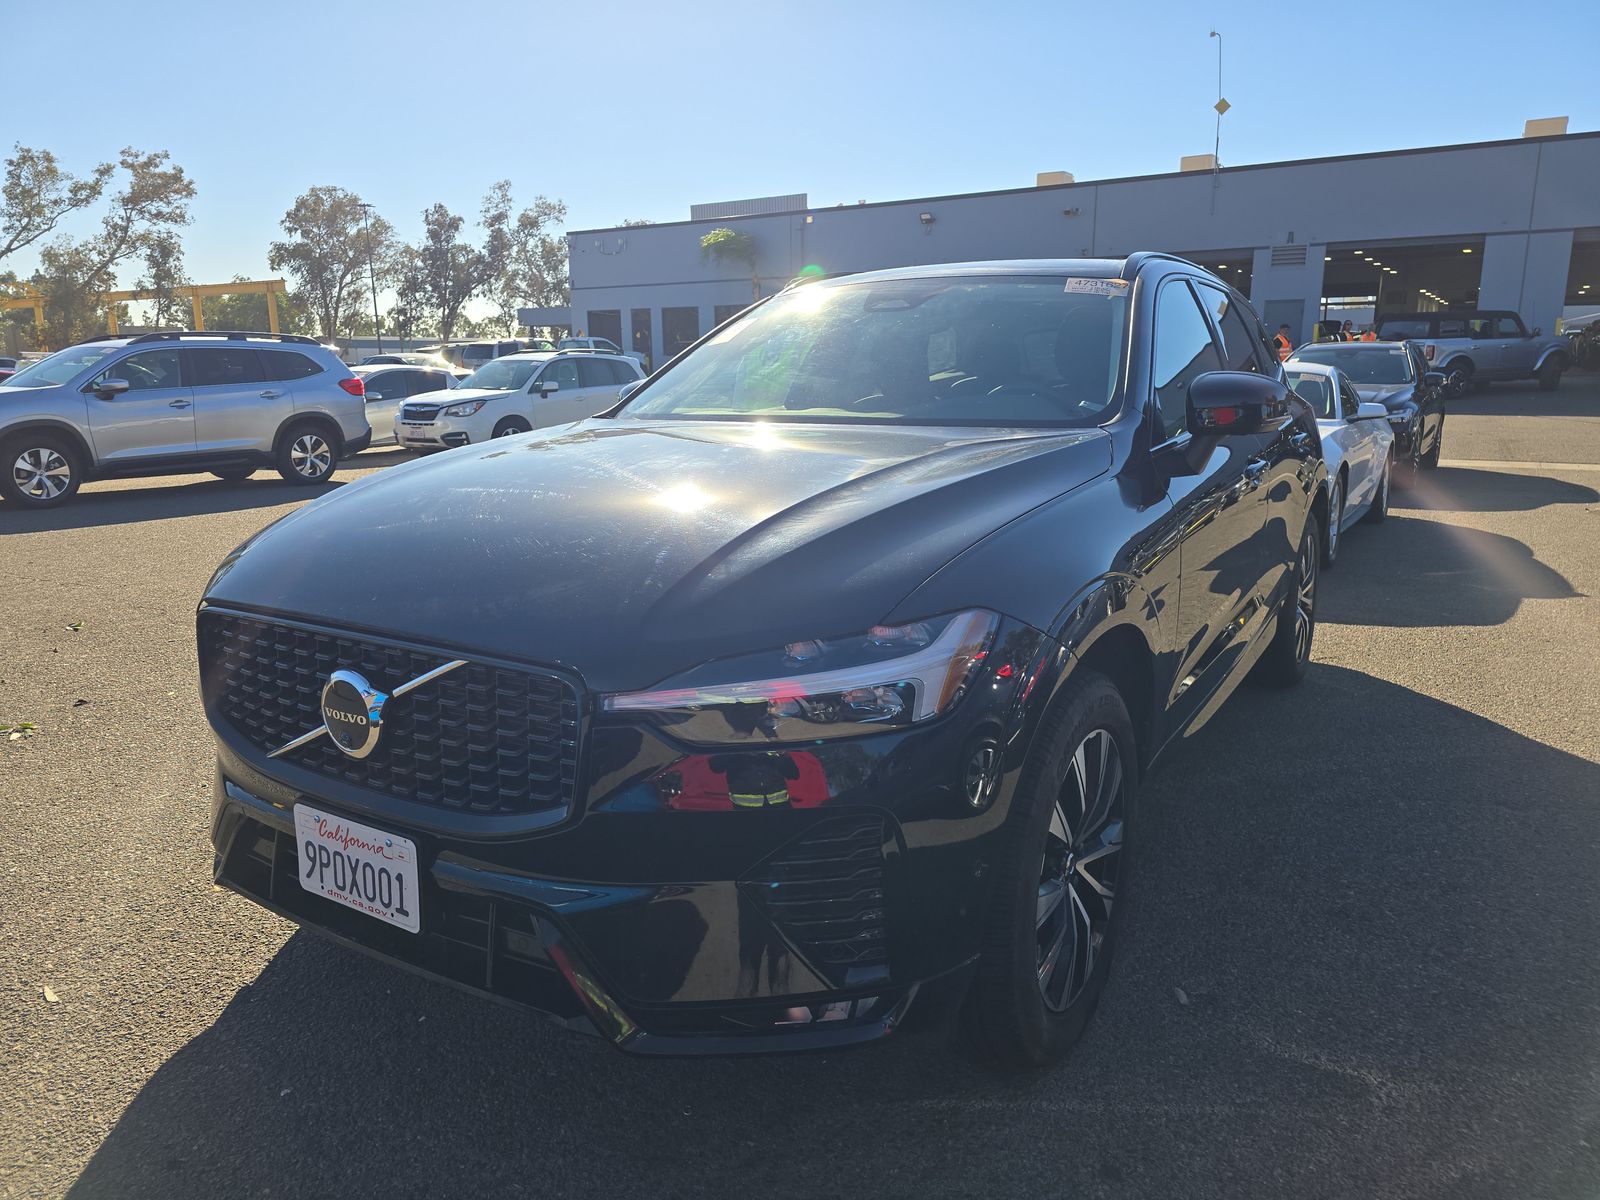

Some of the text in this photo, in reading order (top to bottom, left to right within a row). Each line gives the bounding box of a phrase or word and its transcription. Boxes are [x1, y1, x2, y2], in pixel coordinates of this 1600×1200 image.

[325, 707, 367, 725] VOLVO
[319, 819, 393, 859] California
[327, 888, 388, 917] dmv.ca.gov
